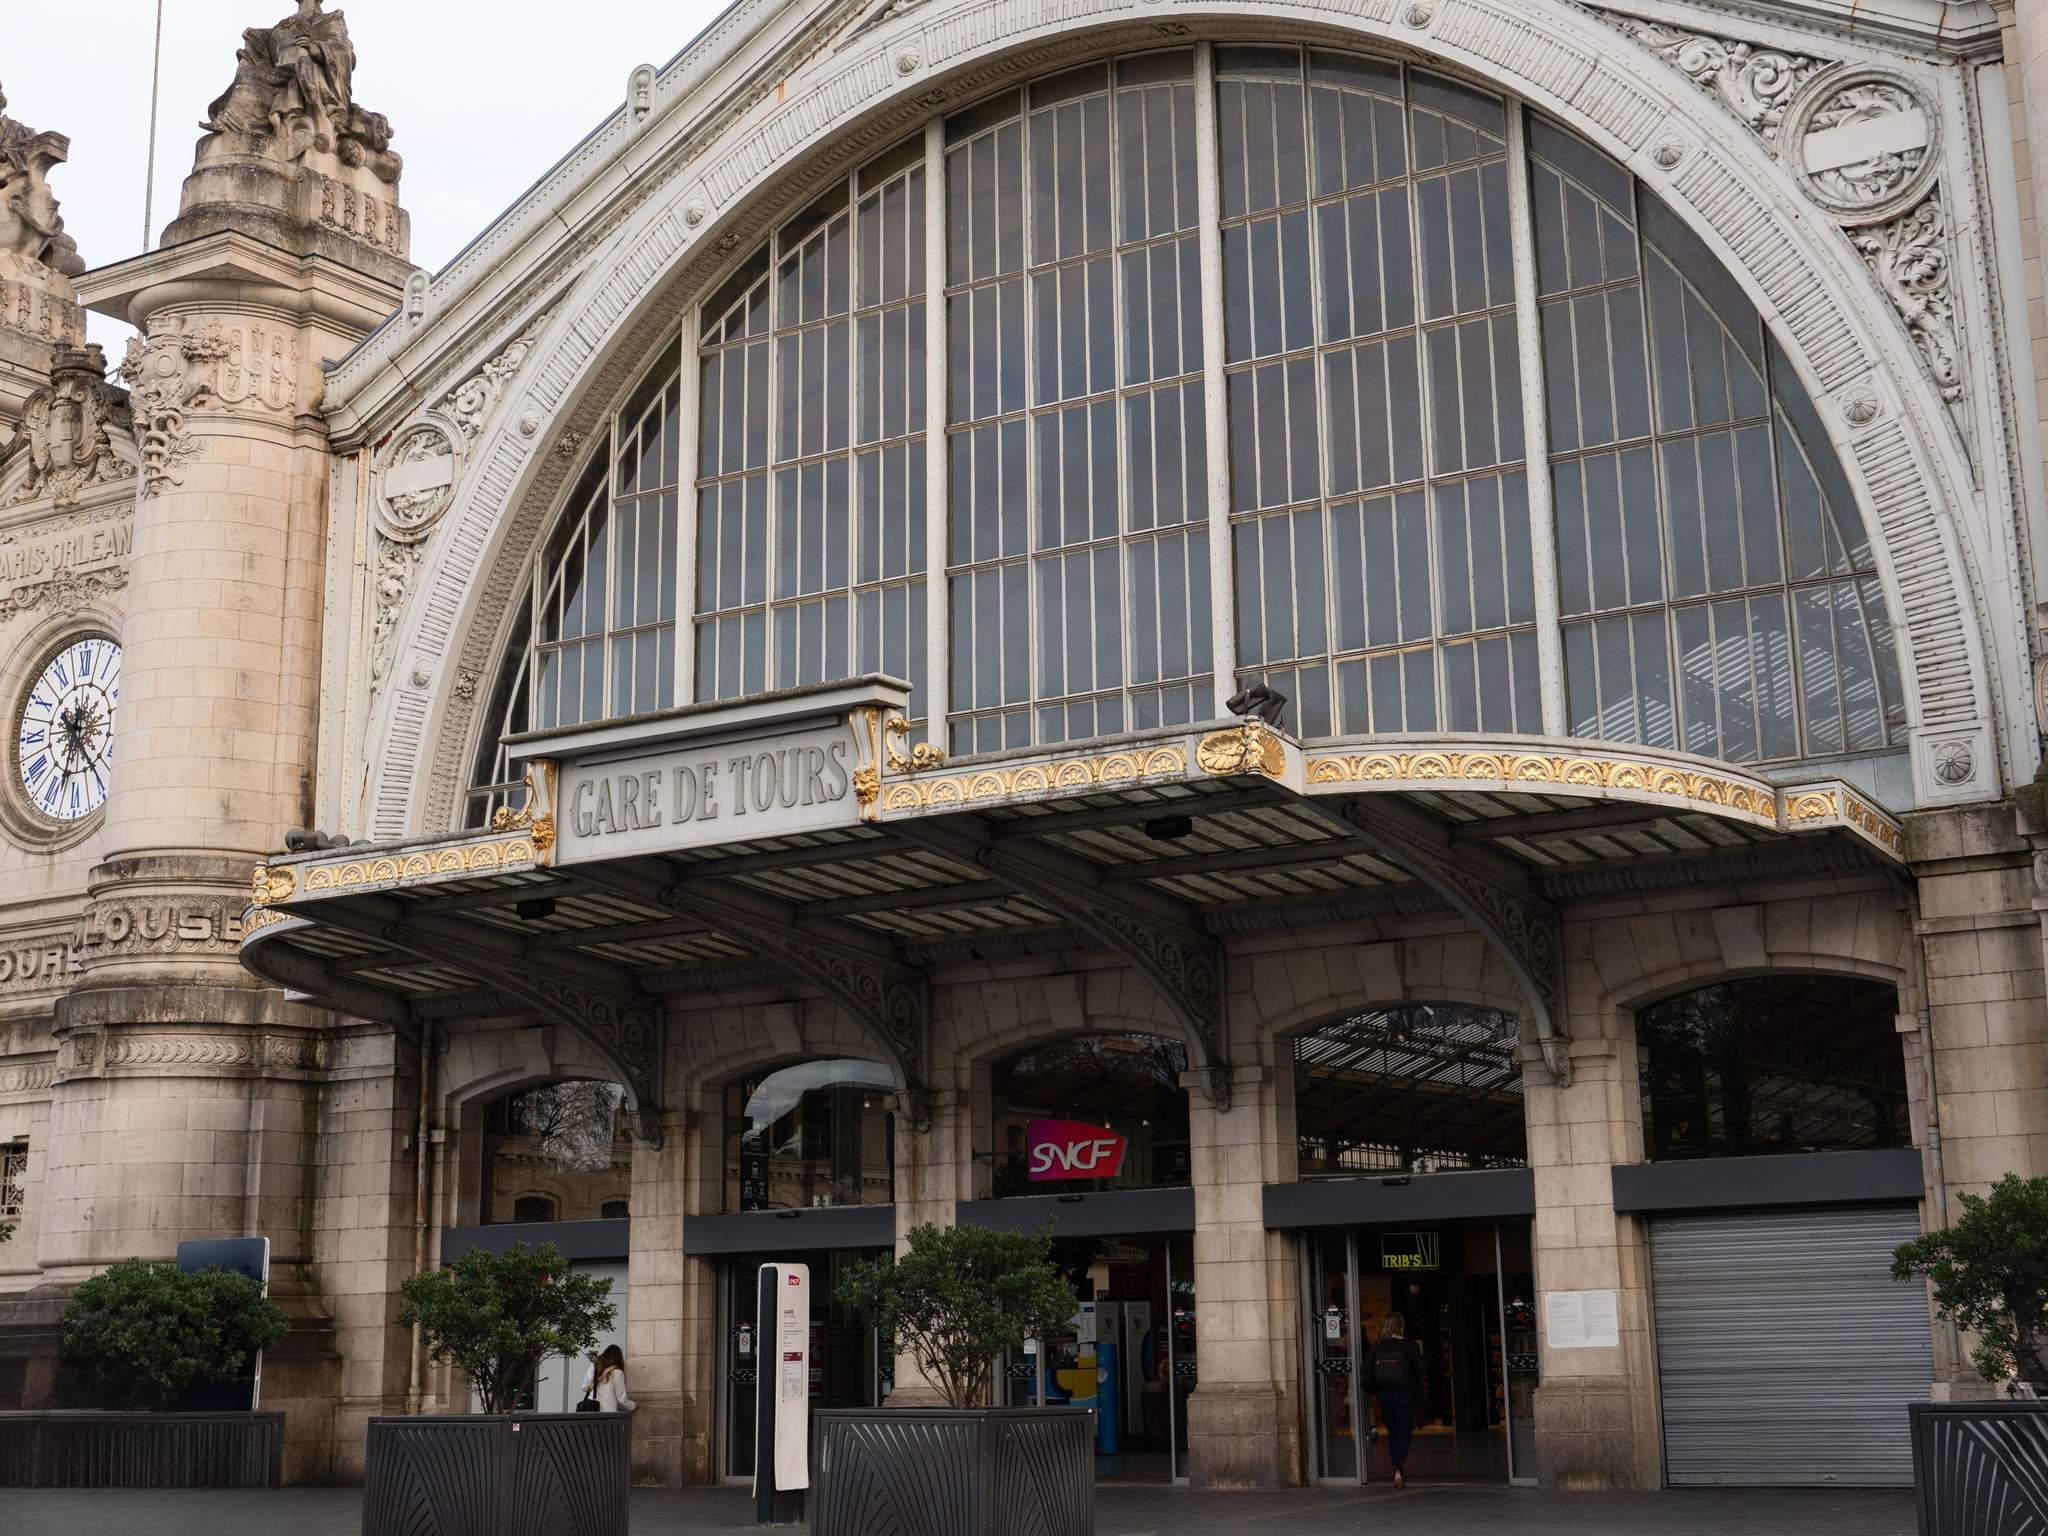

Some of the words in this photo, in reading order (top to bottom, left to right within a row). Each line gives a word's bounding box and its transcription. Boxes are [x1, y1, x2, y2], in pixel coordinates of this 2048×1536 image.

[54, 664, 69, 690] XI
[79, 650, 91, 677] XII
[35, 696, 53, 712] X
[27, 728, 45, 744] IX
[28, 754, 48, 785] VIII
[71, 781, 80, 808] VI
[571, 770, 661, 837] GARE
[672, 761, 718, 825] DE
[728, 741, 848, 815] TOURS
[1030, 1138, 1117, 1172] SNCF
[1383, 1254, 1421, 1267] TRIB'S
